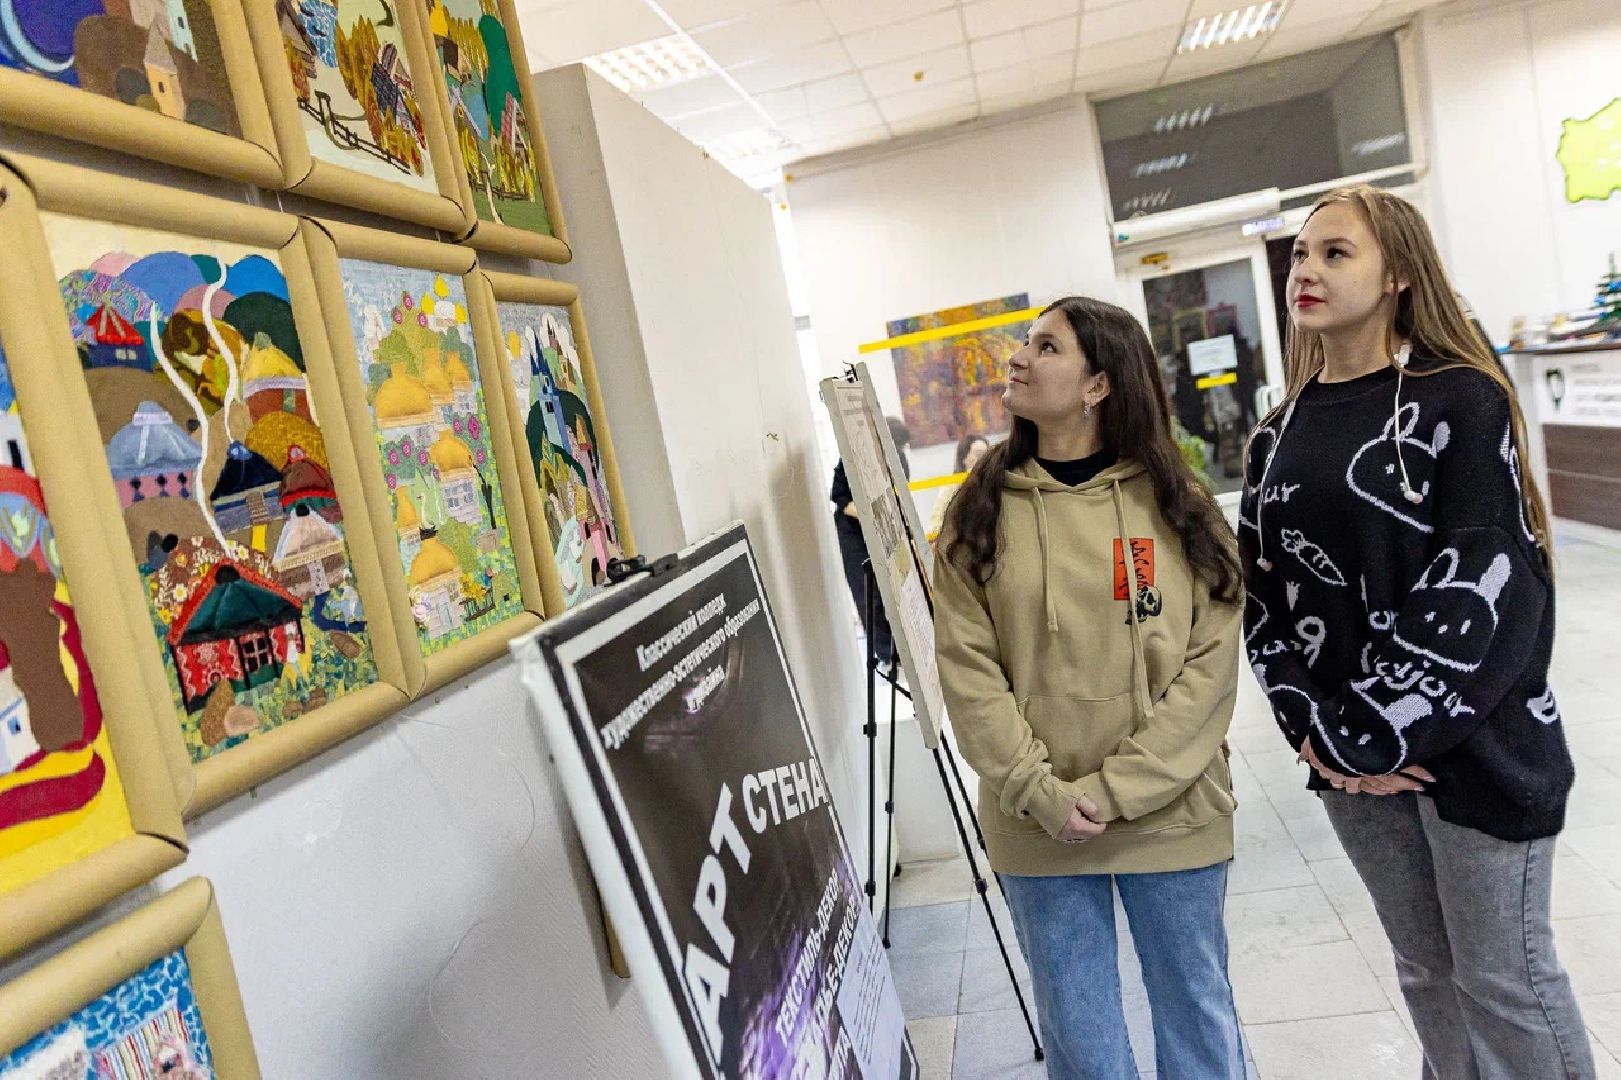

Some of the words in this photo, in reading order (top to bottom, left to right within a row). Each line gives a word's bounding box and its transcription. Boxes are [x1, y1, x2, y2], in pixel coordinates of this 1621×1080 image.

[686, 782, 751, 1065] АРТ
[742, 758, 828, 834] СТЕНА
[776, 868, 840, 1046] ТЕКСТИЛЬ-ДЕКОР
